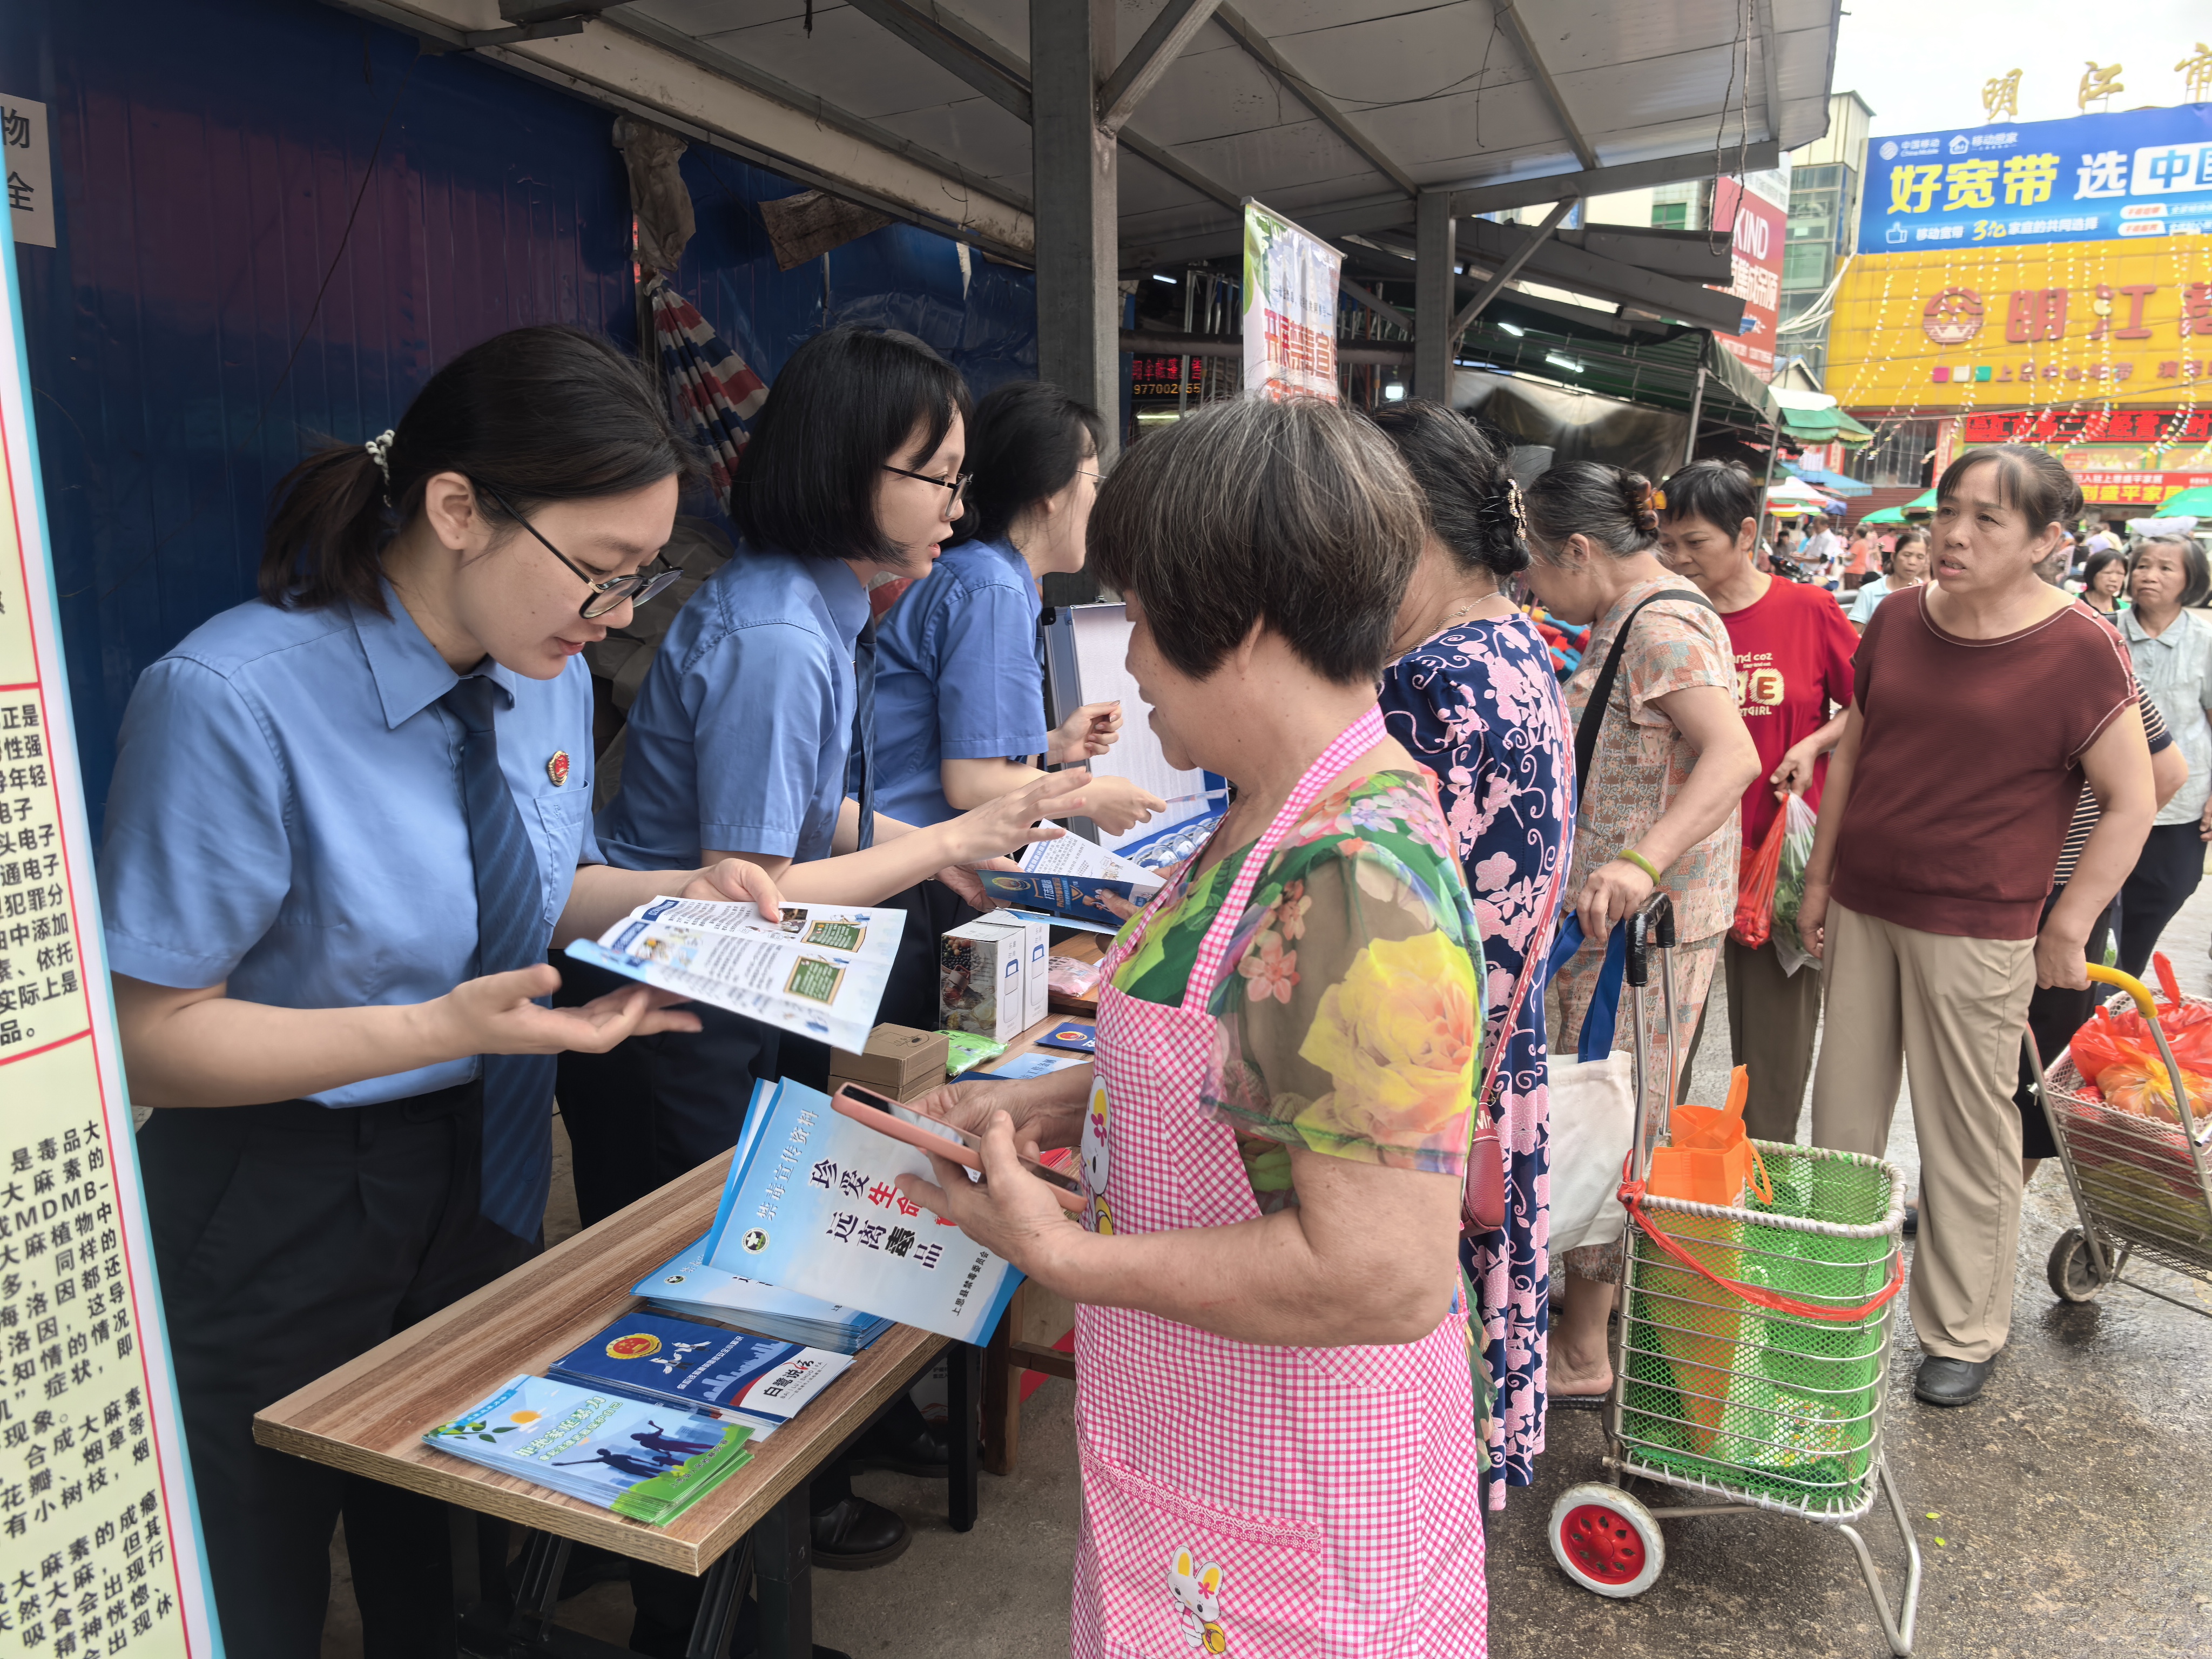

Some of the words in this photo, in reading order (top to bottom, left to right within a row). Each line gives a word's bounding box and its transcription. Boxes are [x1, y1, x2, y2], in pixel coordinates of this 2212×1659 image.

[1901, 138, 1940, 150] 中国移动
[7, 171, 34, 212] 全
[1887, 153, 2060, 215] 好宽带
[2073, 150, 2128, 201] 选
[1916, 225, 1964, 241] 移动宽带
[1133, 383, 1202, 395] 97700255
[0, 734, 43, 761] 性强
[0, 882, 64, 919] 犯罪分
[756, 1109, 819, 1222] 禁毒宣传资料
[826, 1210, 943, 1270] 远离毒品
[952, 1251, 989, 1317] 上思县禁毒委员会
[763, 1359, 814, 1397] 白鹭说法
